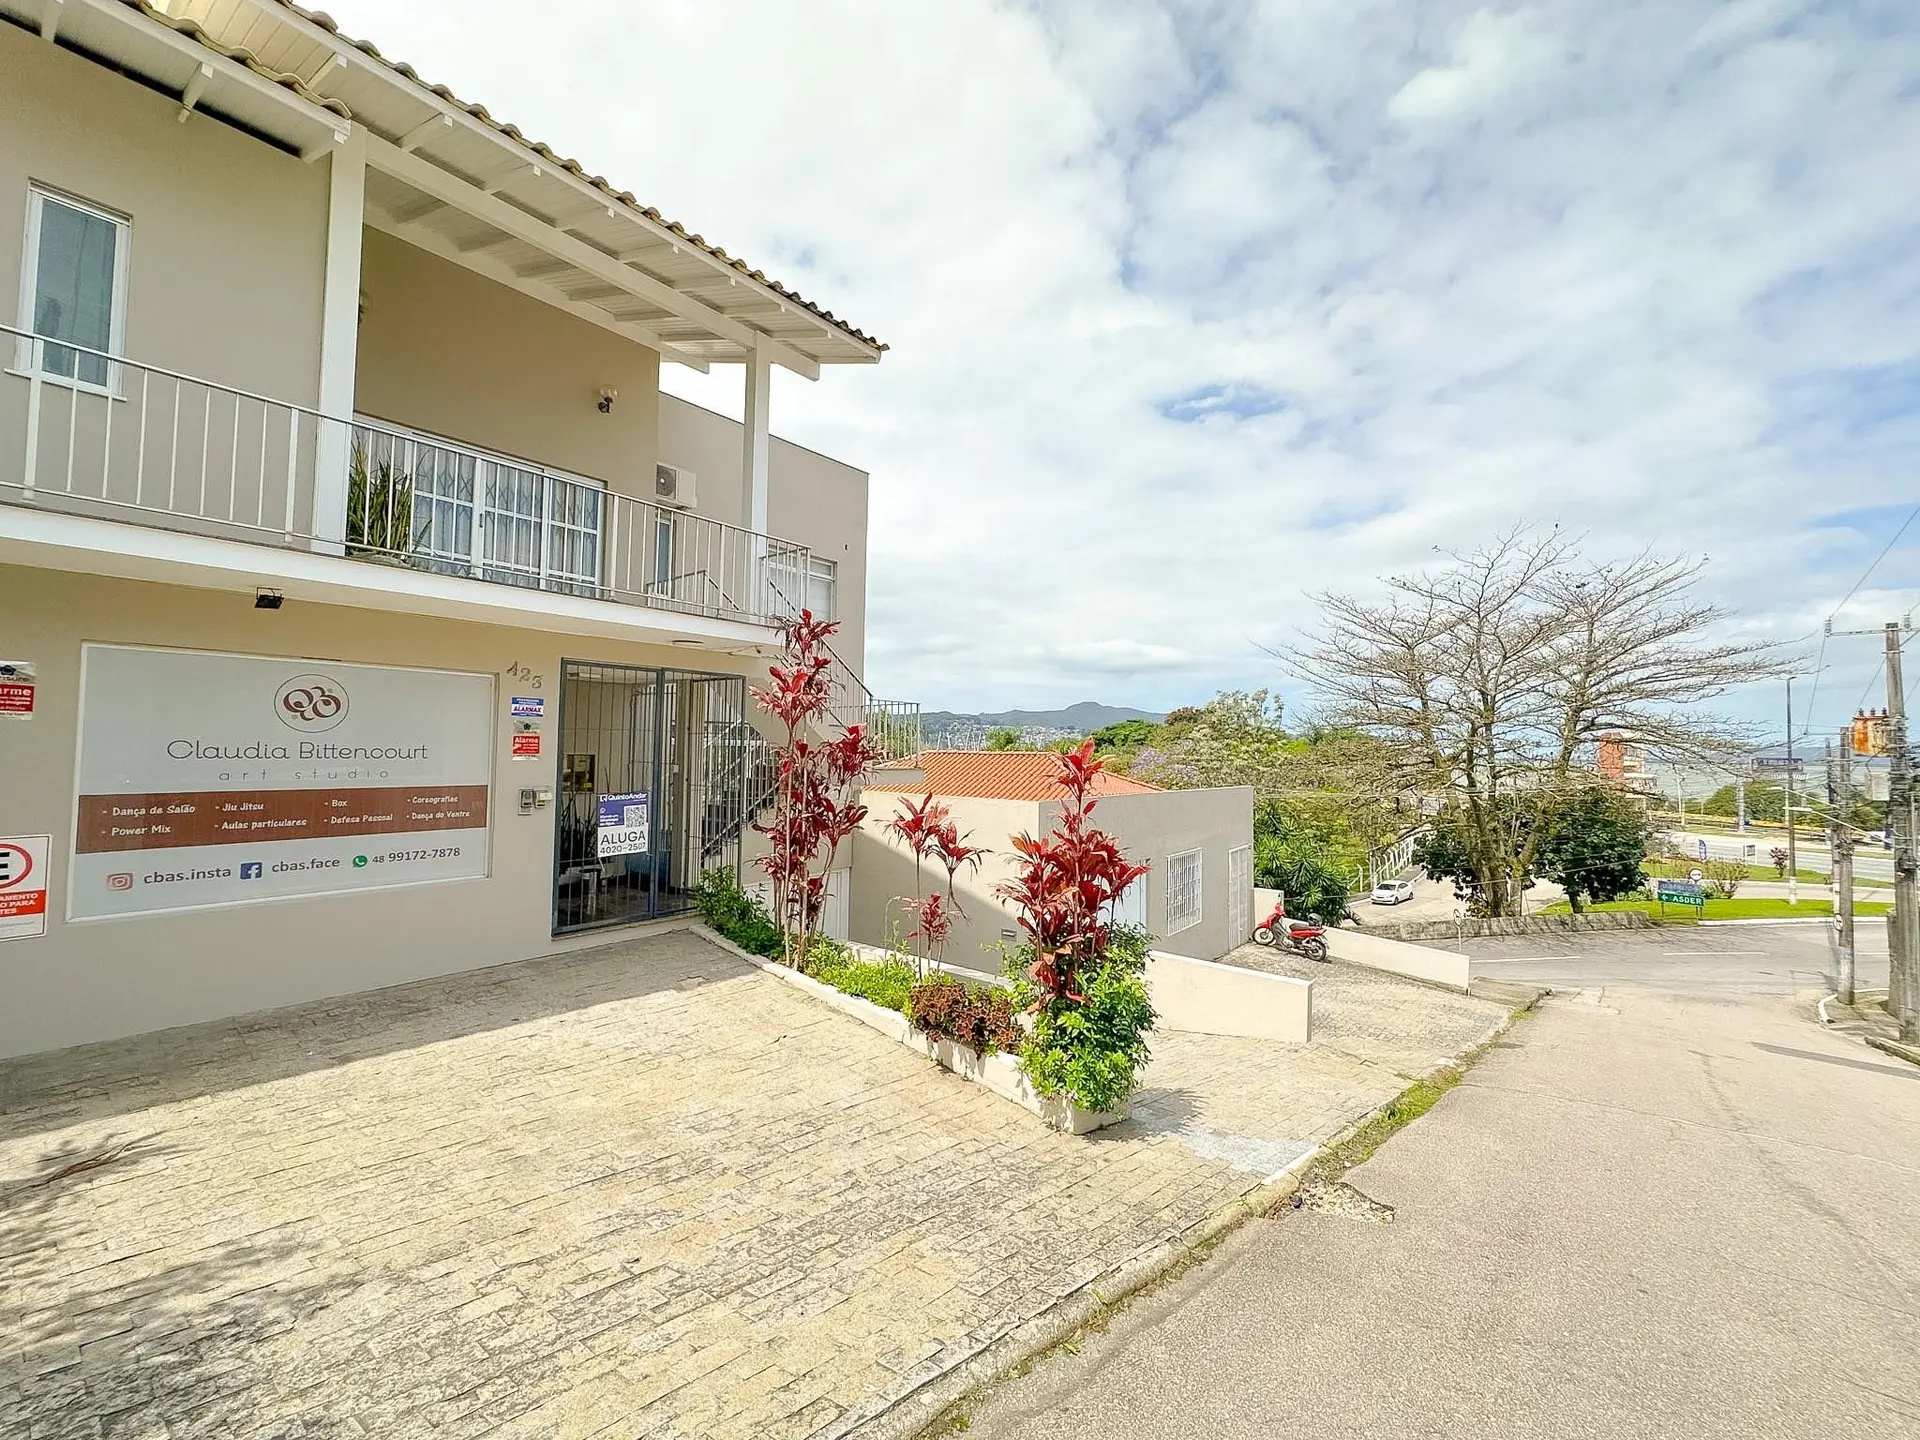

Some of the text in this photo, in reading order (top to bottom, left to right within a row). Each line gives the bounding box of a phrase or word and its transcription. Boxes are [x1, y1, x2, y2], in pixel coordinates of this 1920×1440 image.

[506, 660, 543, 689] 423
[166, 739, 428, 760] Claudia Bittencourt
[218, 768, 389, 781] art studio
[412, 795, 459, 805] Coreografias
[608, 793, 647, 801] QuintoAndar
[222, 802, 264, 812] Jiu Jitsu
[331, 799, 348, 808] Box
[112, 802, 196, 818] Dança de Salão
[411, 810, 471, 821] Dança do Ventre
[221, 818, 307, 830] Aulas particulares
[330, 813, 393, 825] Defesa Pessoal
[111, 825, 172, 837] Power Mix
[600, 830, 646, 846] ALUGA
[372, 847, 461, 864] 48 99172-7878
[272, 858, 340, 873] cbas.face
[143, 867, 232, 884] cbas.insta
[9, 899, 36, 908] PARA
[1672, 895, 1702, 905] ASDER
